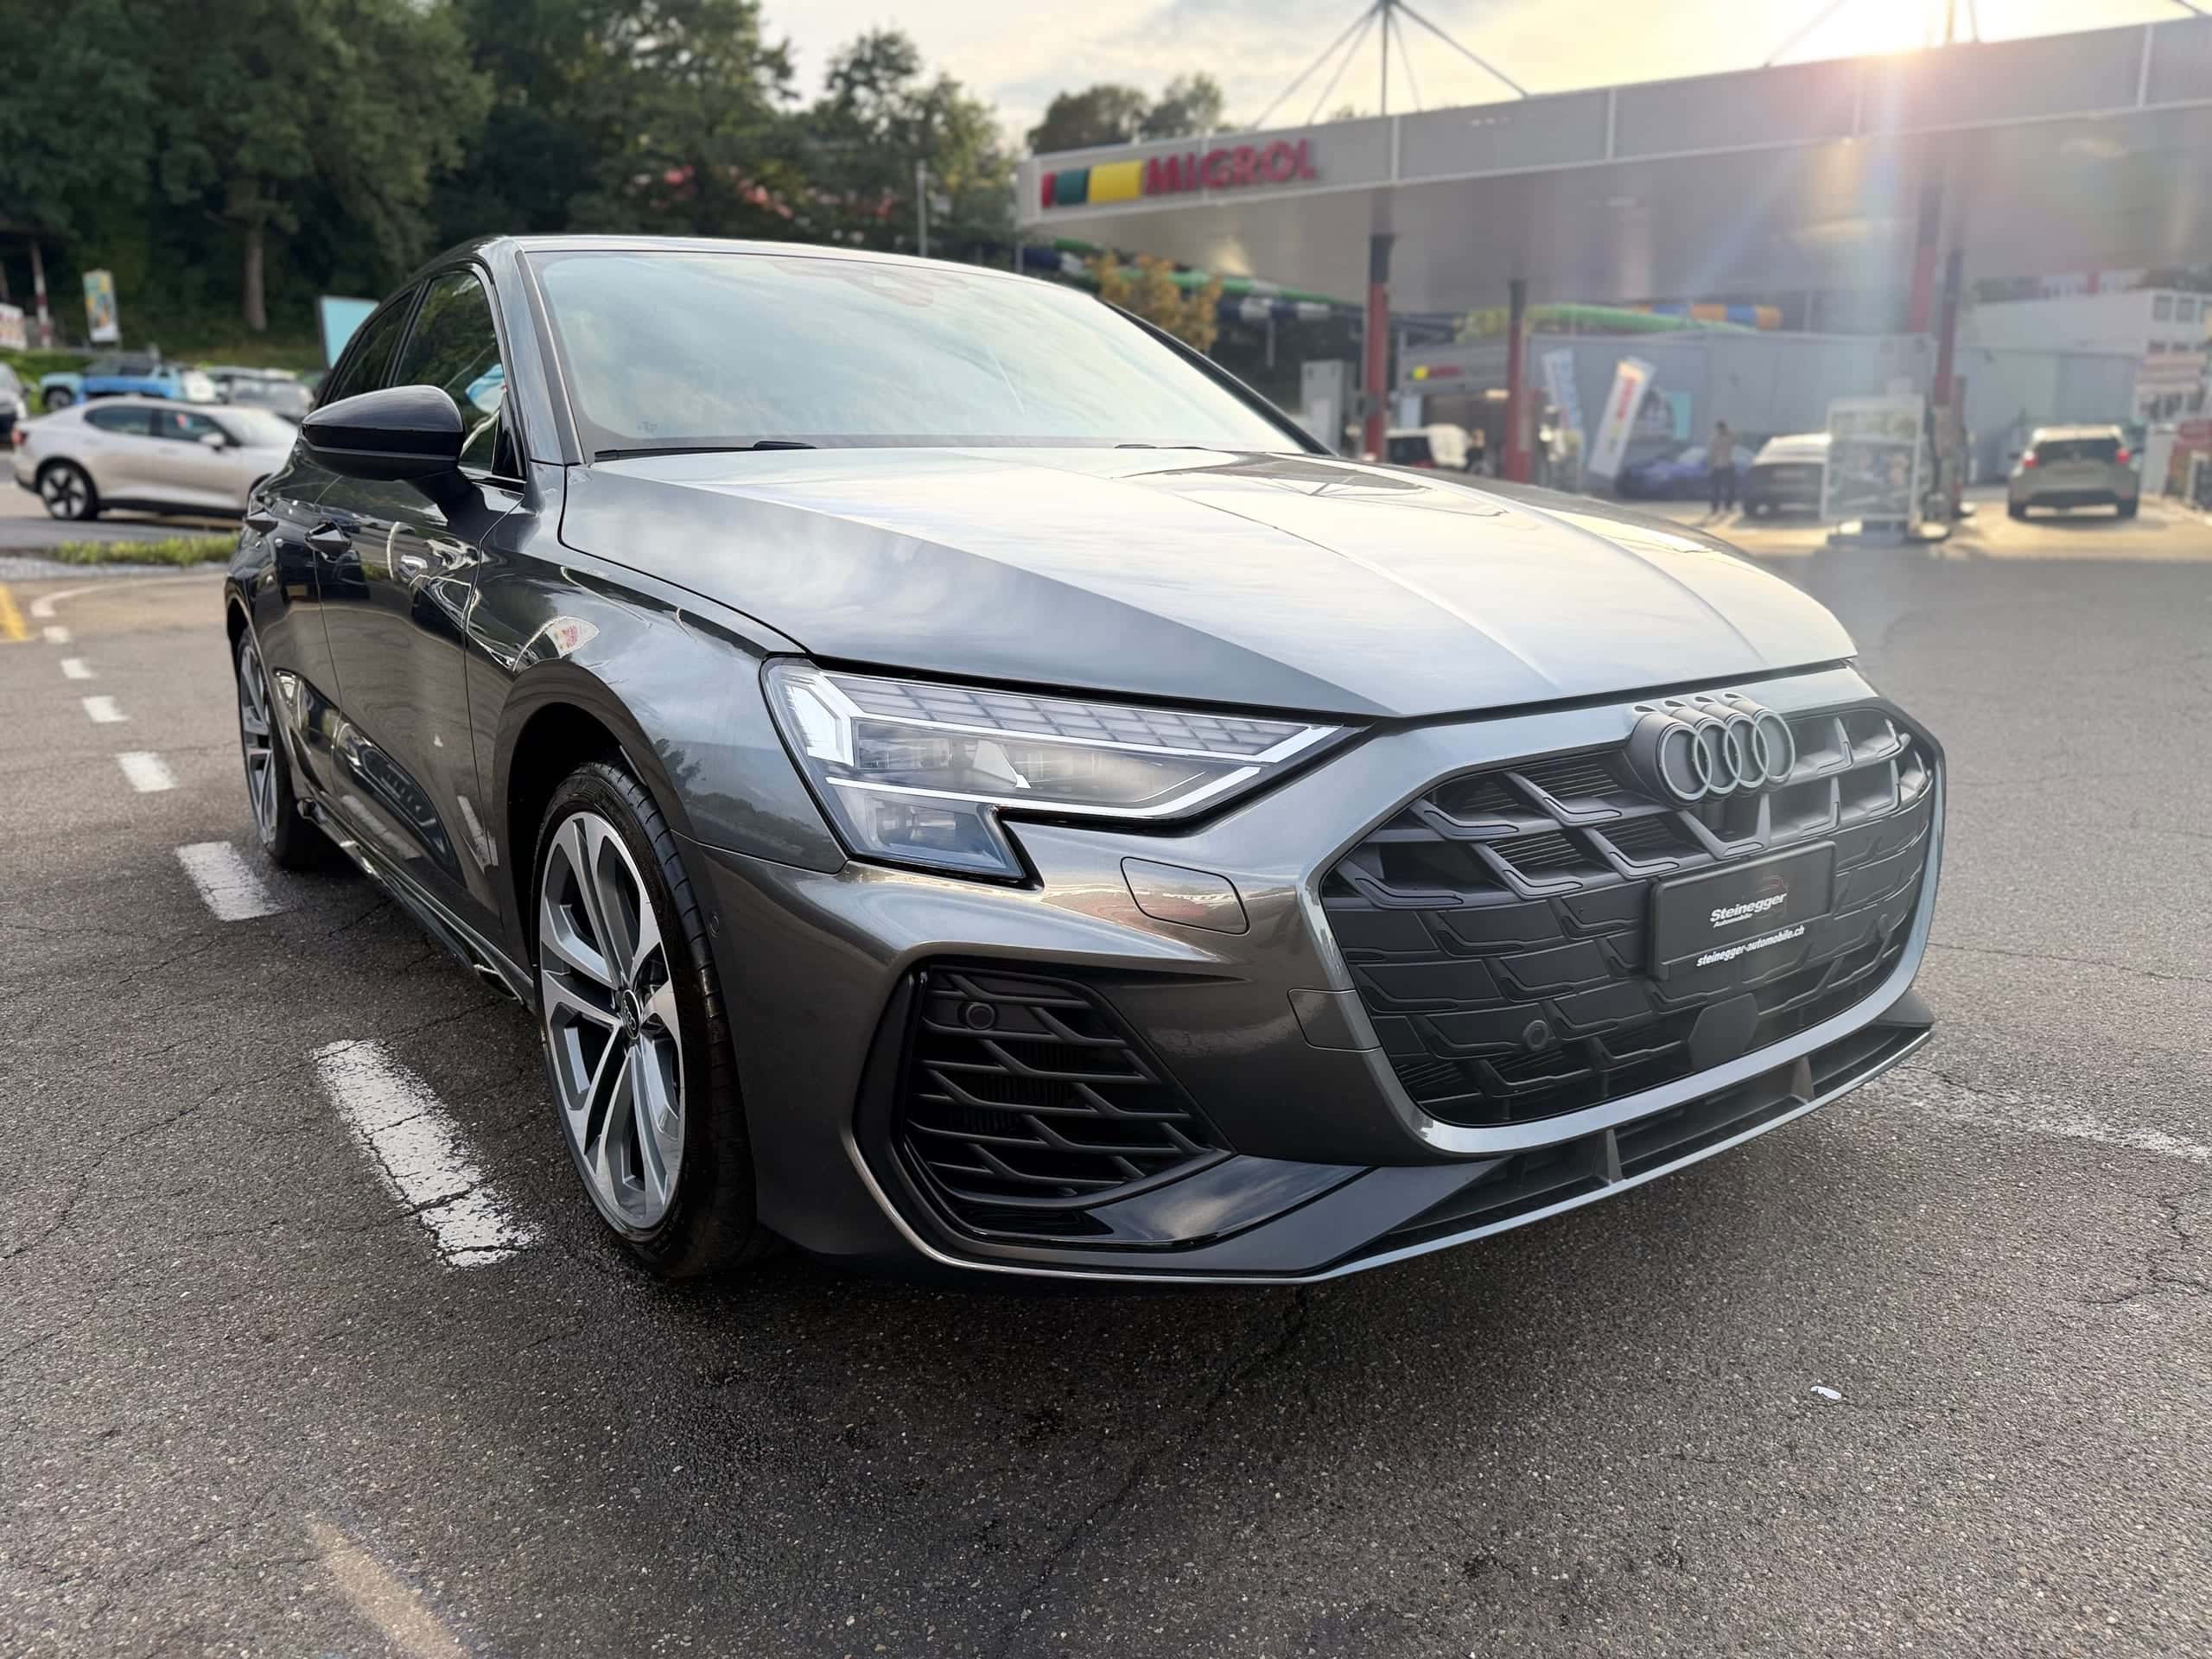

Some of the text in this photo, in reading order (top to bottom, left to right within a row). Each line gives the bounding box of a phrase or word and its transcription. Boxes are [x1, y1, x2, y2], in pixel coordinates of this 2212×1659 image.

[1144, 138, 1318, 195] MIGROL
[1710, 893, 1787, 922] Steinegger
[1696, 925, 1805, 966] steinegger-automobile.ch
